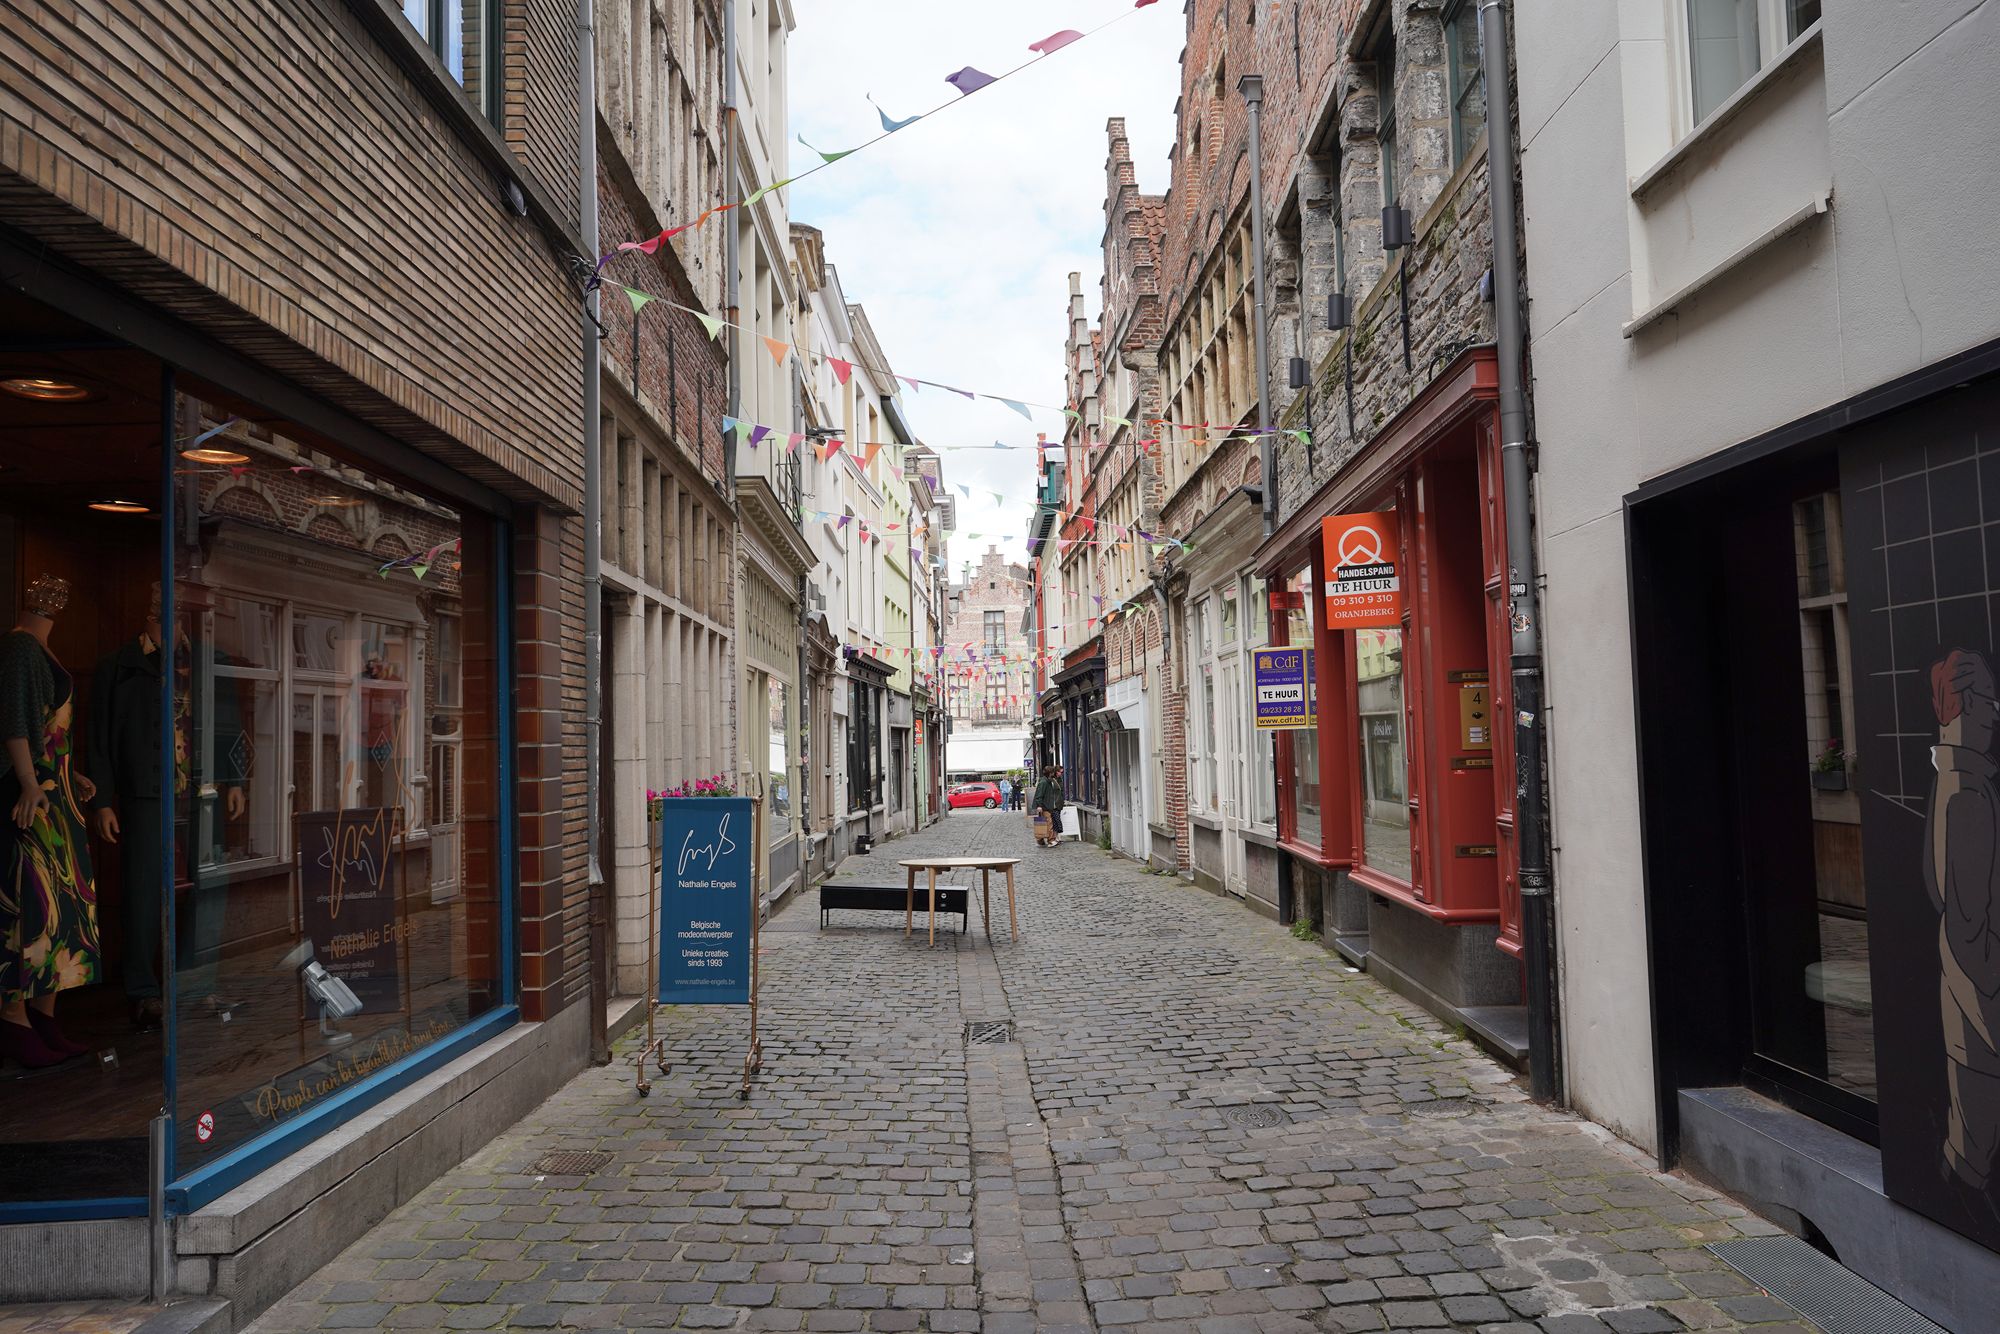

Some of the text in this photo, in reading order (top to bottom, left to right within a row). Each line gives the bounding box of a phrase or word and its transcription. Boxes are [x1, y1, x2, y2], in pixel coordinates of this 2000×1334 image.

[1338, 566, 1395, 578] HANDELSPAND
[1333, 579, 1392, 593] TE HUUR
[1333, 594, 1393, 606] 09 310 9 310
[1334, 607, 1395, 619] ORANJEBERG
[1274, 655, 1299, 669] CdF
[1263, 690, 1298, 699] TE HUUR
[1473, 691, 1482, 705] 4
[1261, 706, 1282, 714] 09/233
[1293, 705, 1302, 713] 28
[1259, 716, 1304, 724] www.cdf.be
[678, 880, 737, 890] Nathalie Engels
[690, 921, 721, 930] Belgische
[330, 928, 380, 960] Nathalie
[383, 919, 418, 944] Engels
[677, 931, 734, 940] modeontwerpster
[681, 949, 729, 958] Unieke creaties
[687, 959, 723, 967] sinds 1993
[675, 978, 736, 986] www.nathalie-engels.be
[256, 1079, 314, 1122] People
[316, 1076, 340, 1096] can
[337, 1060, 355, 1084] be
